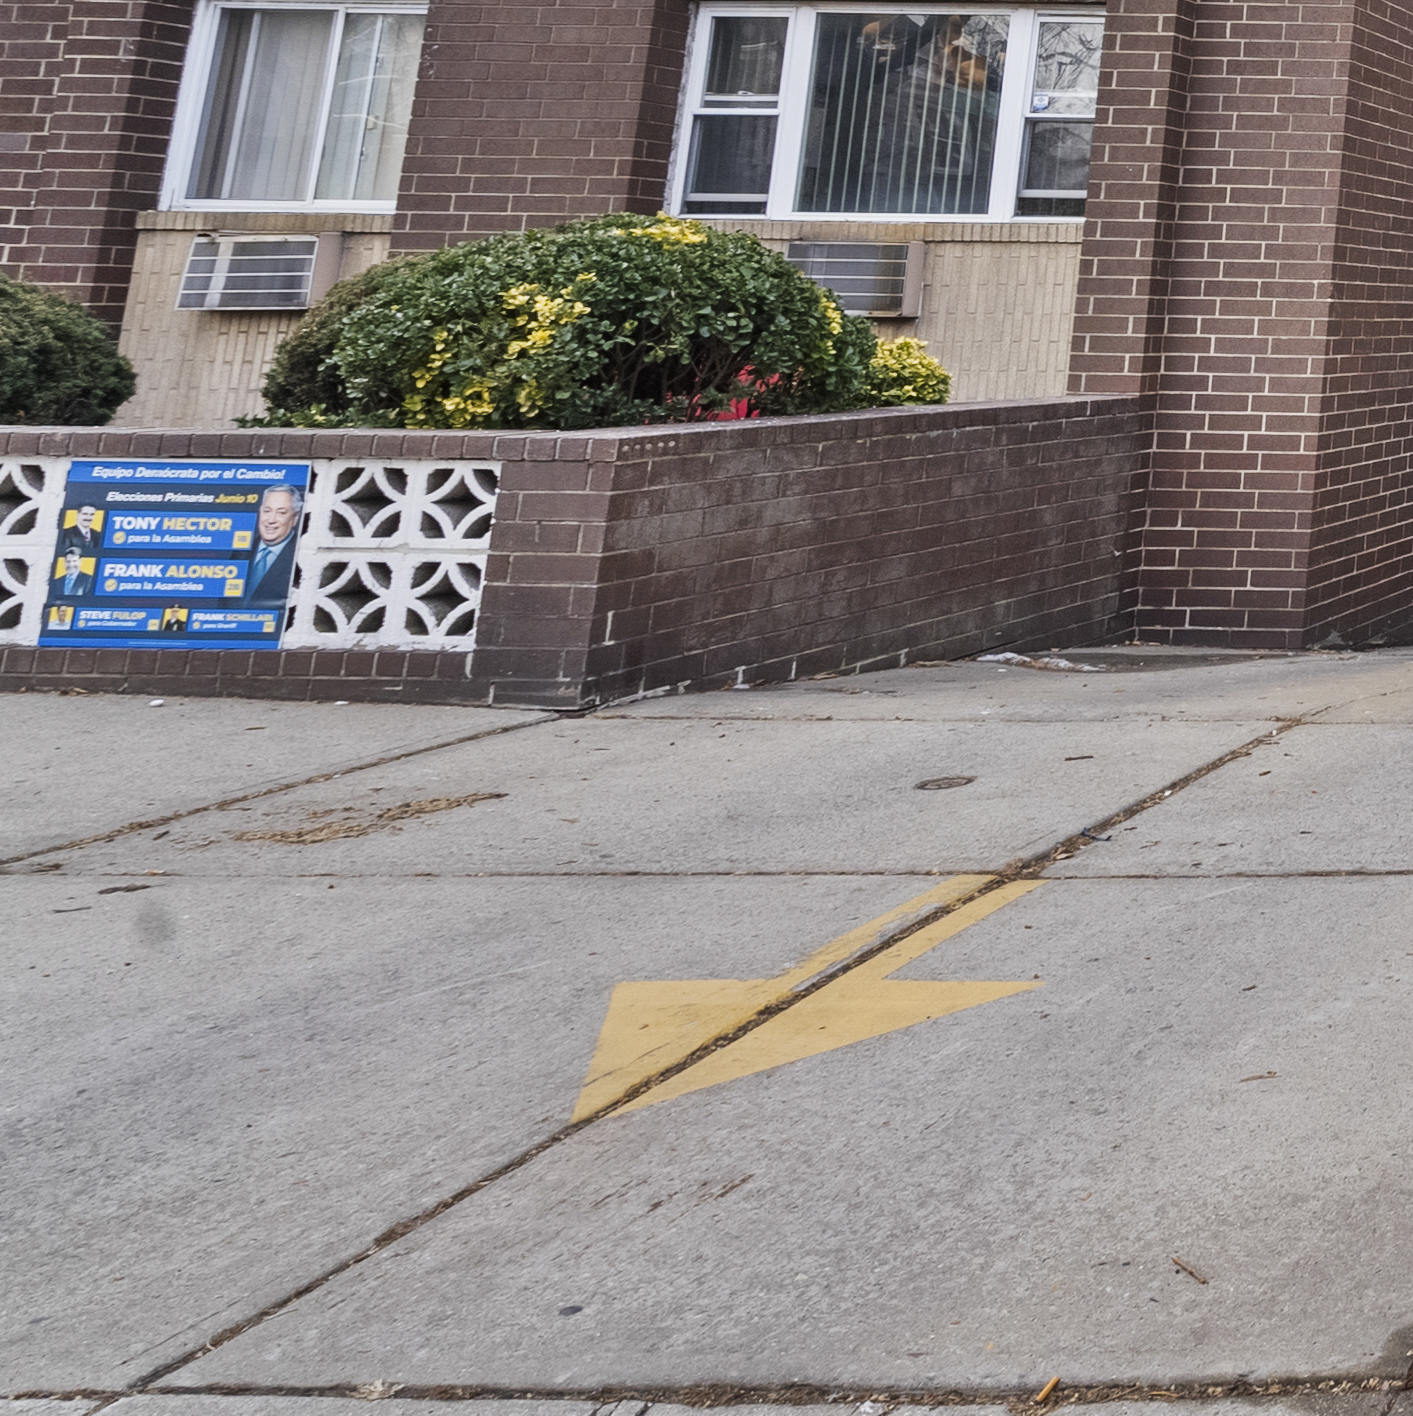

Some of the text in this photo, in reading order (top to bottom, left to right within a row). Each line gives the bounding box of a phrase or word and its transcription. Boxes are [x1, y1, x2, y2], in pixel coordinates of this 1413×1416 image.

[92, 466, 285, 480] Equipo Demócrata por el Cambio!
[106, 492, 259, 503] Elecciones Primarias Junio 10
[113, 516, 232, 531] TONY HECTOR
[127, 534, 212, 544] para la Asamblea
[104, 563, 238, 578] FRANK ALONSO
[118, 581, 204, 591] para la Asamblea
[80, 610, 112, 619] STEVE
[192, 613, 226, 621] FRANK
